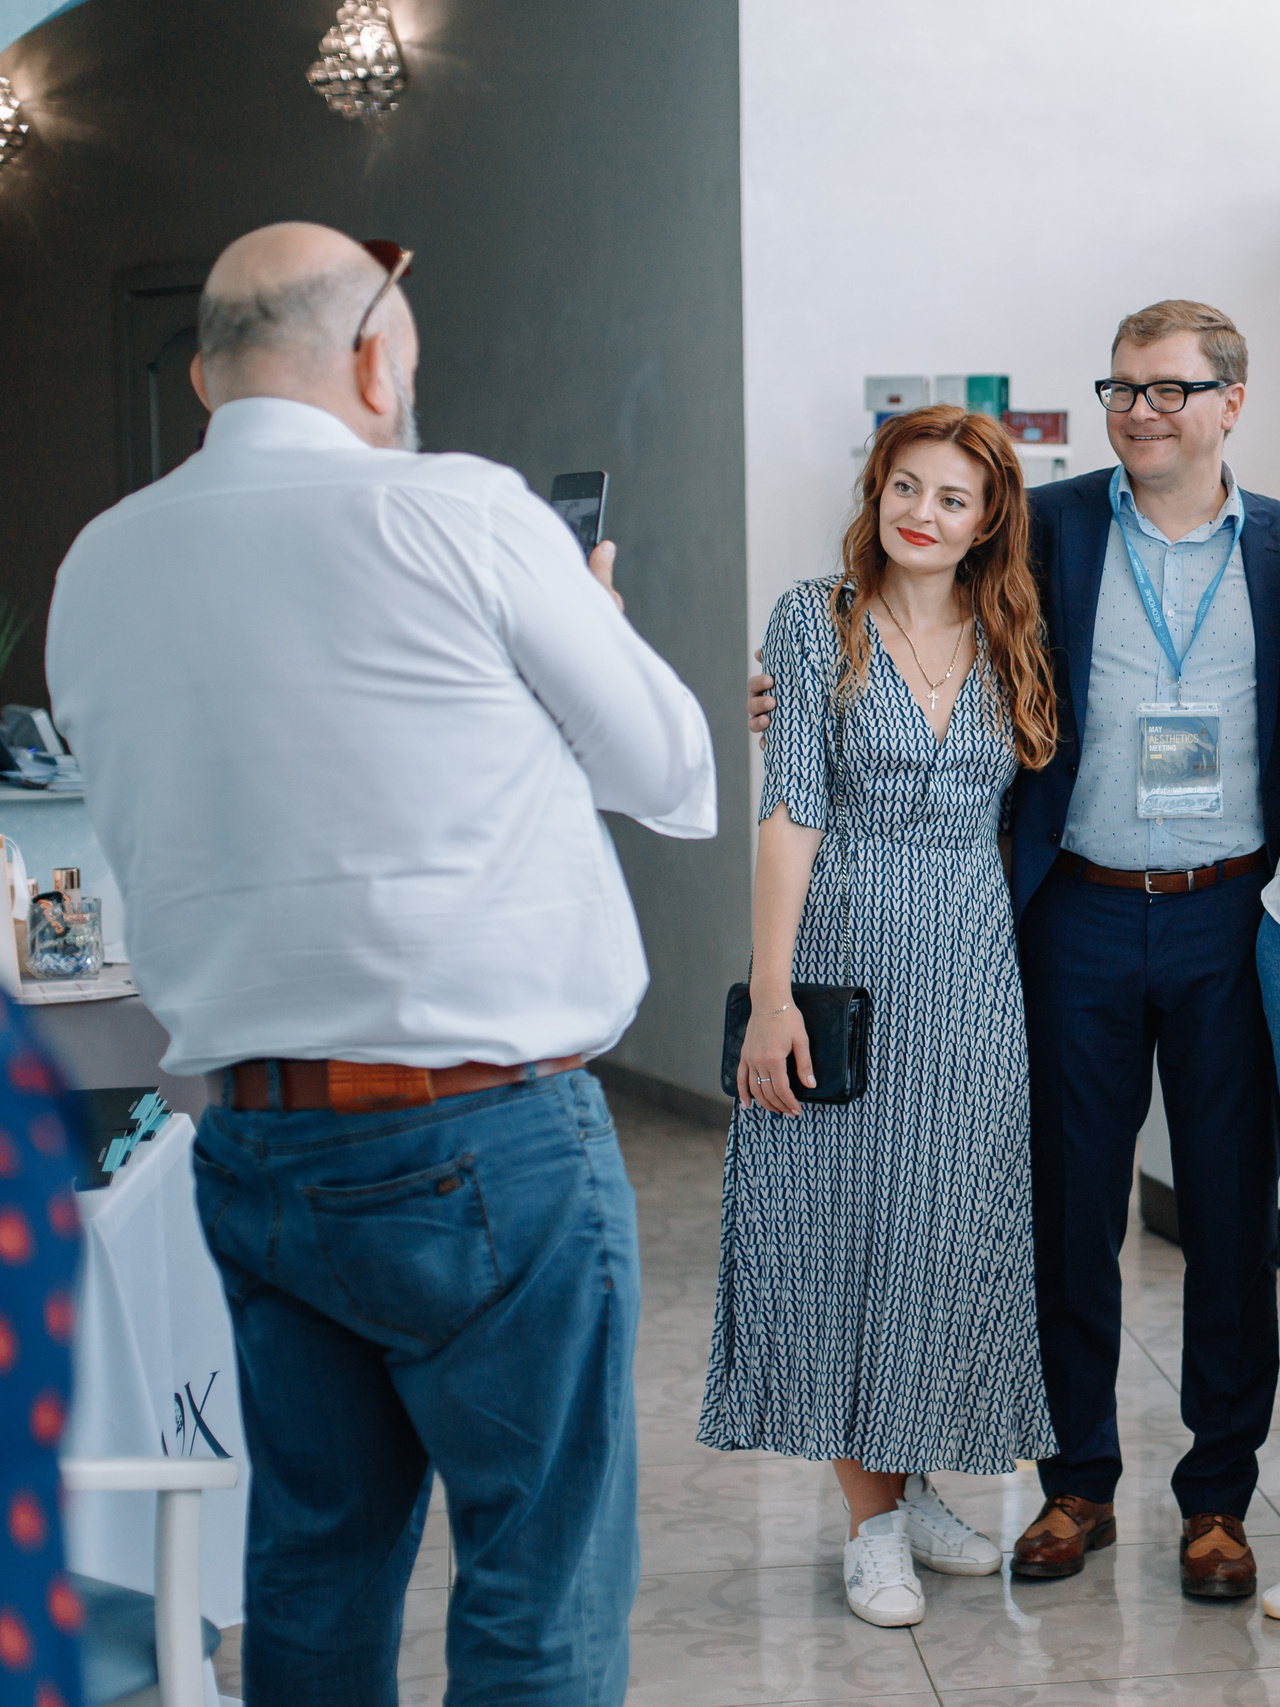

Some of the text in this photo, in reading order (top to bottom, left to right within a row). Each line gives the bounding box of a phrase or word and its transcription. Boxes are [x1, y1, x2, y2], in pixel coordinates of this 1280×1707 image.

[1144, 588, 1162, 627] MEDHOME
[1148, 733, 1199, 745] AESTHETICS
[1149, 744, 1177, 752] MEETING
